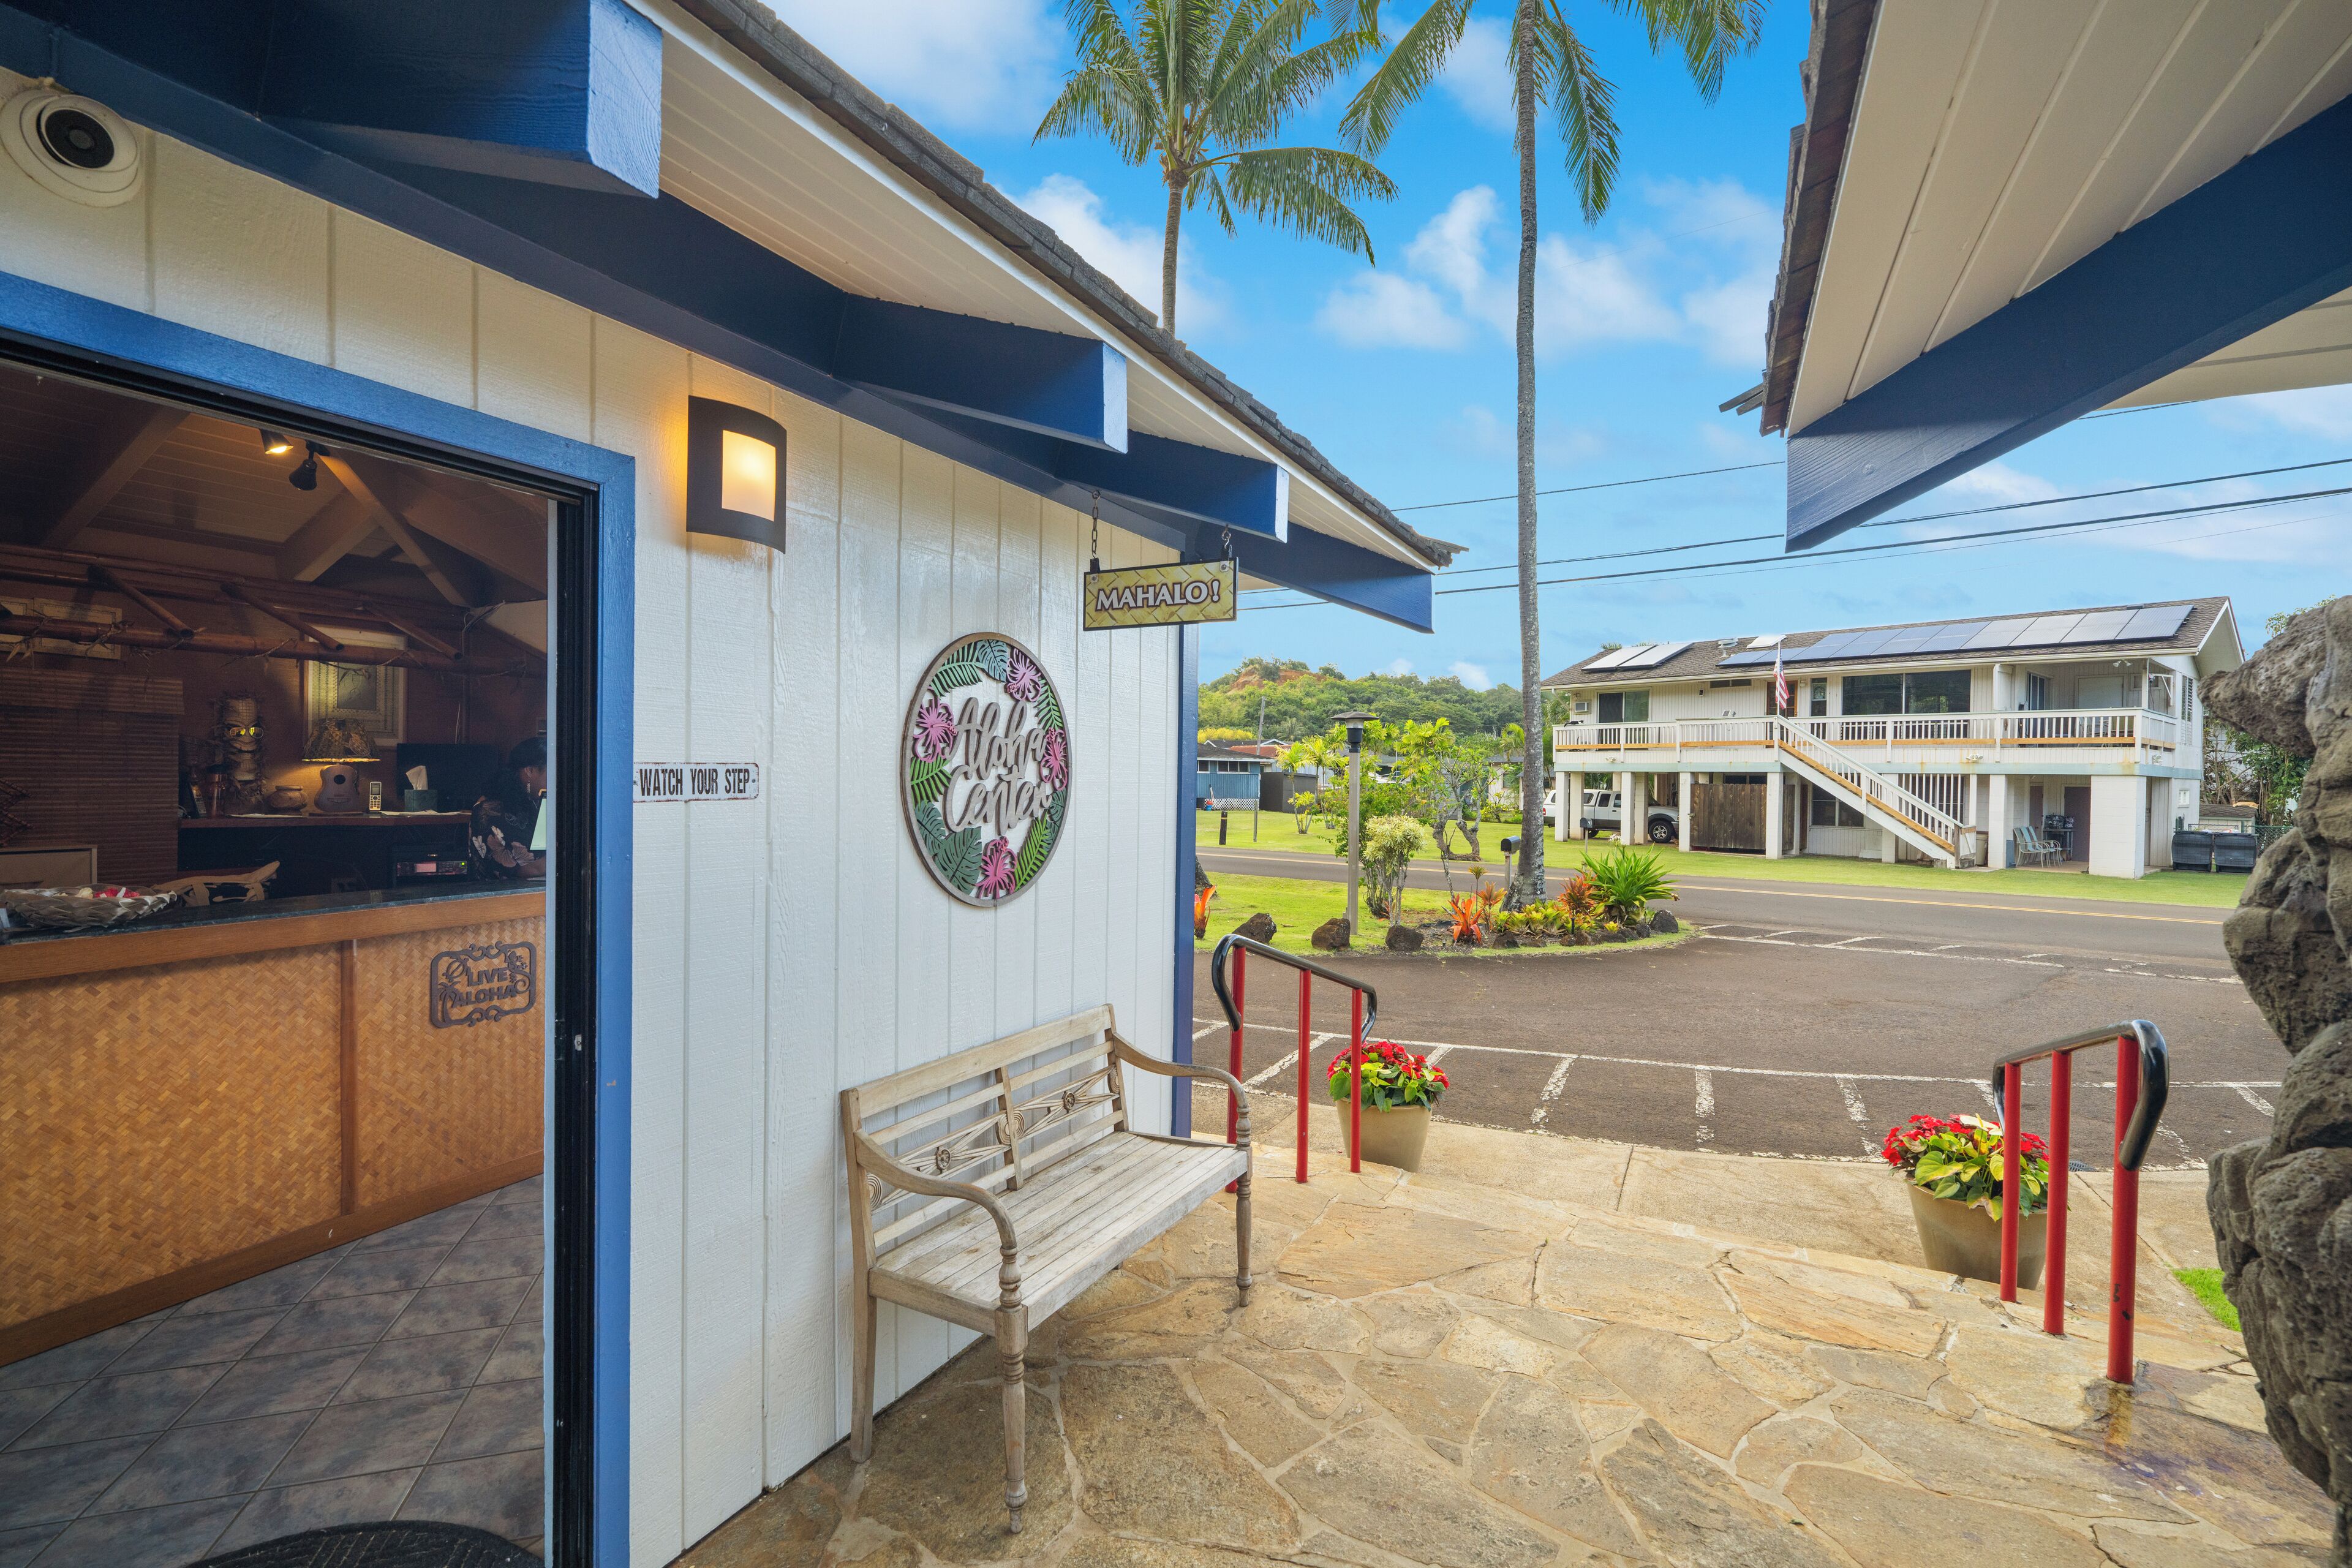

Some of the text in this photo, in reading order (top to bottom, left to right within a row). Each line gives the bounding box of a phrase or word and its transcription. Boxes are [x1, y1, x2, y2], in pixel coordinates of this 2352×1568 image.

[1095, 579, 1221, 612] MAHALO!
[944, 696, 1047, 780] Aloha
[639, 768, 750, 796] WATCH YOUR STEP
[943, 764, 1053, 835] Center
[466, 966, 508, 987] LIVE
[451, 984, 517, 1008] ALOHA
